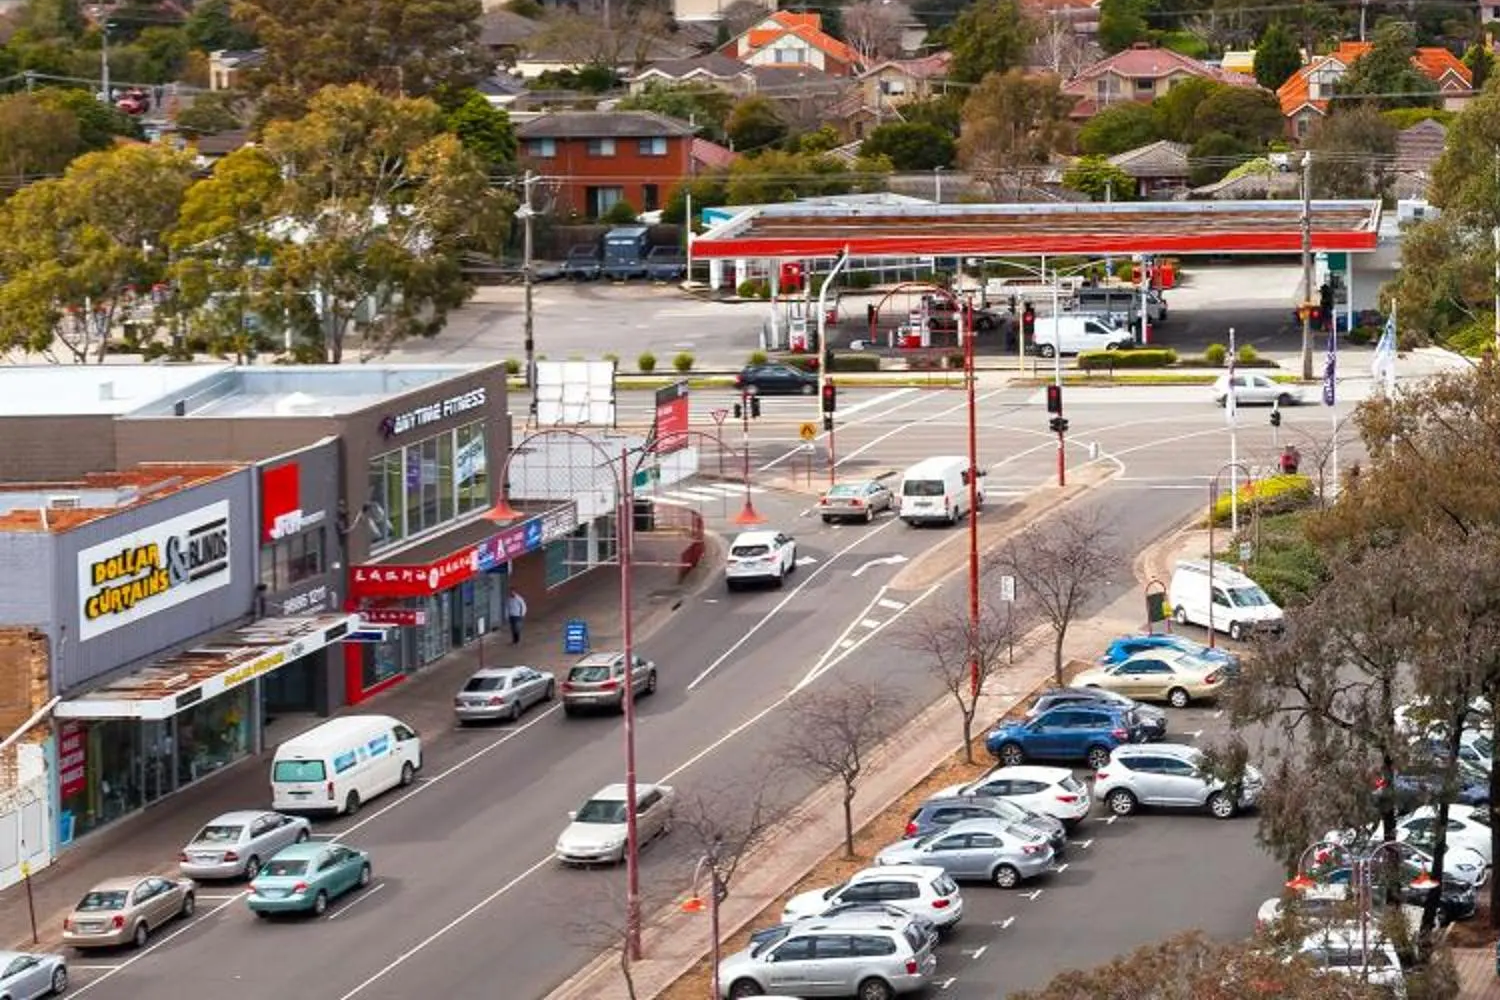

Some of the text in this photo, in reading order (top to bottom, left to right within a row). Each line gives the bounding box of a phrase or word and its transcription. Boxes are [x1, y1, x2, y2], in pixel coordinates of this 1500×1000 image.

[91, 543, 160, 586] DOLLAR
[166, 535, 190, 588] &
[188, 528, 228, 570] BLINDS
[85, 566, 169, 620] CURTAINS
